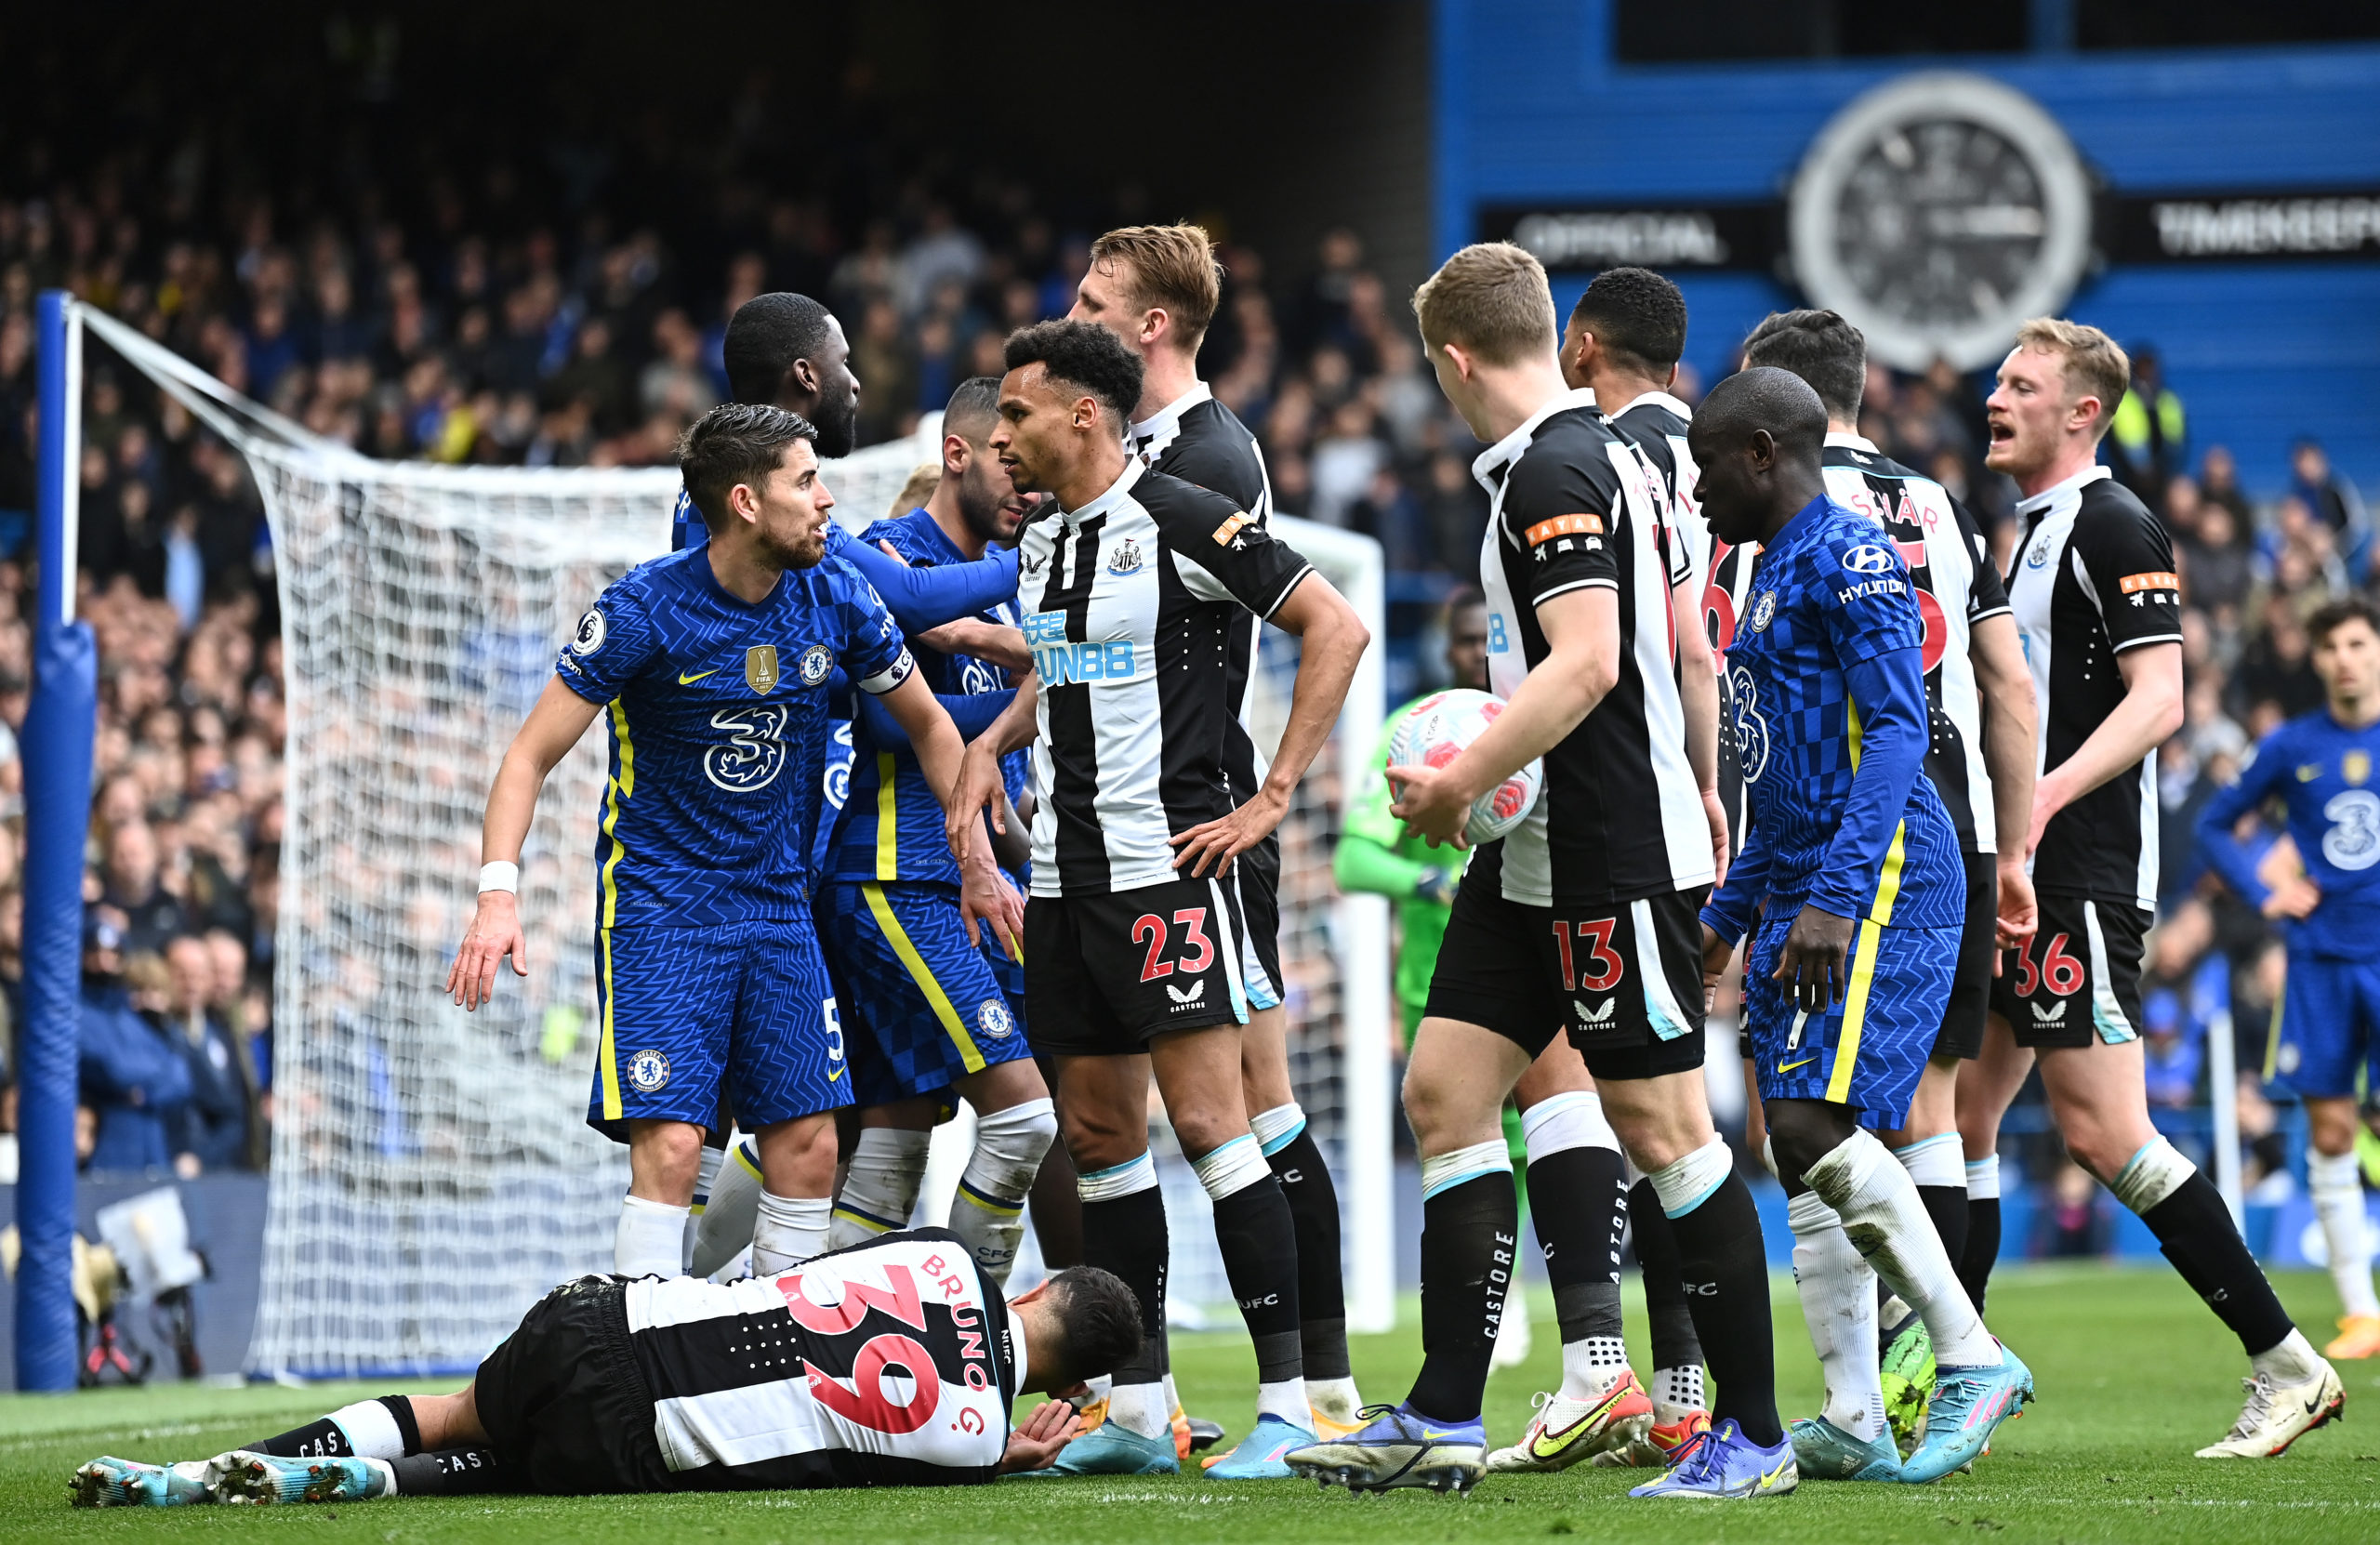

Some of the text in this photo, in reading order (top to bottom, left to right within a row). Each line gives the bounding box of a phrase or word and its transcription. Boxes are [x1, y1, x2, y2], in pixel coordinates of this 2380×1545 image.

[1515, 214, 1726, 264] OFFICIAL
[1527, 516, 1601, 545] KAYAK
[1131, 907, 1215, 984] 23
[1552, 917, 1624, 992] 13
[2014, 932, 2085, 998] 36
[1170, 1001, 1206, 1013] CASTORE
[1578, 1022, 1617, 1031] CASTORE
[823, 997, 844, 1062] 5
[633, 1051, 661, 1062] CHELSEA
[977, 1247, 1014, 1258] CFC
[1484, 1231, 1514, 1339] CASTORE
[1682, 1281, 1718, 1296] FC
[920, 1254, 988, 1393] BRUNO
[775, 1263, 940, 1435] 39
[1000, 1328, 1012, 1365] NUFC
[299, 1431, 350, 1458] CAS
